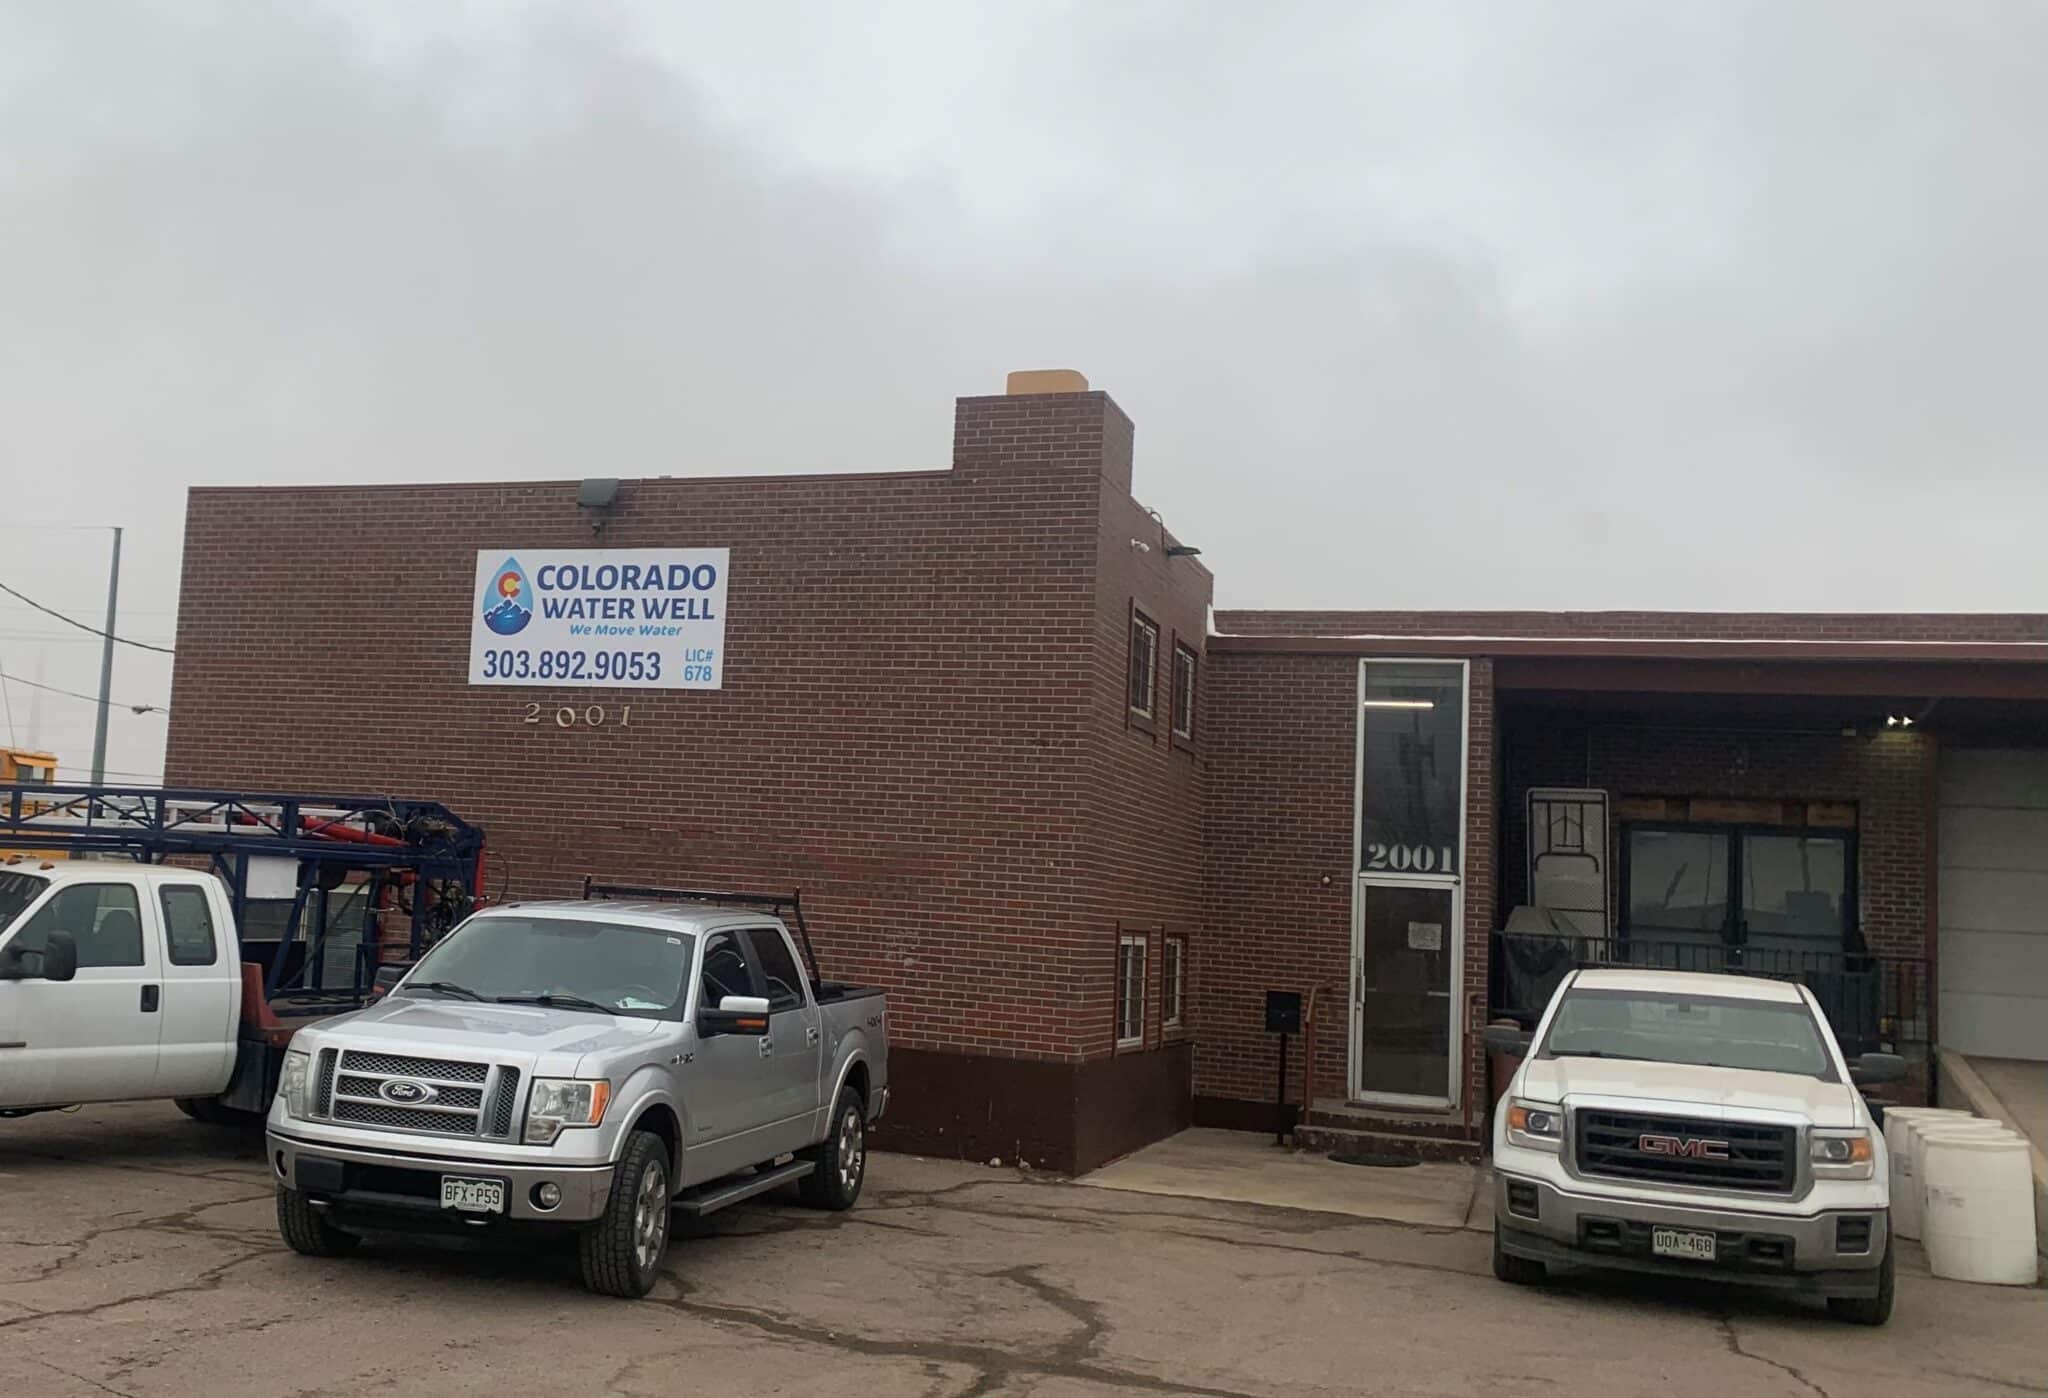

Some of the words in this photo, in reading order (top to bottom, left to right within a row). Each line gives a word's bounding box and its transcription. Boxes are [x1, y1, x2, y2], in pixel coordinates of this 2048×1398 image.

[537, 565, 717, 590] COLORADO
[542, 598, 635, 619] WATER
[642, 598, 714, 620] WELL
[570, 625, 592, 635] We
[595, 625, 635, 635] Move
[639, 625, 683, 636] Water
[483, 650, 661, 681] 303.892.9053
[685, 648, 714, 662] LIC#
[684, 665, 712, 682] 678
[524, 703, 631, 727] 2001
[1368, 844, 1453, 872] 2001
[392, 1085, 416, 1097] Ford
[1640, 1135, 1728, 1159] GMC
